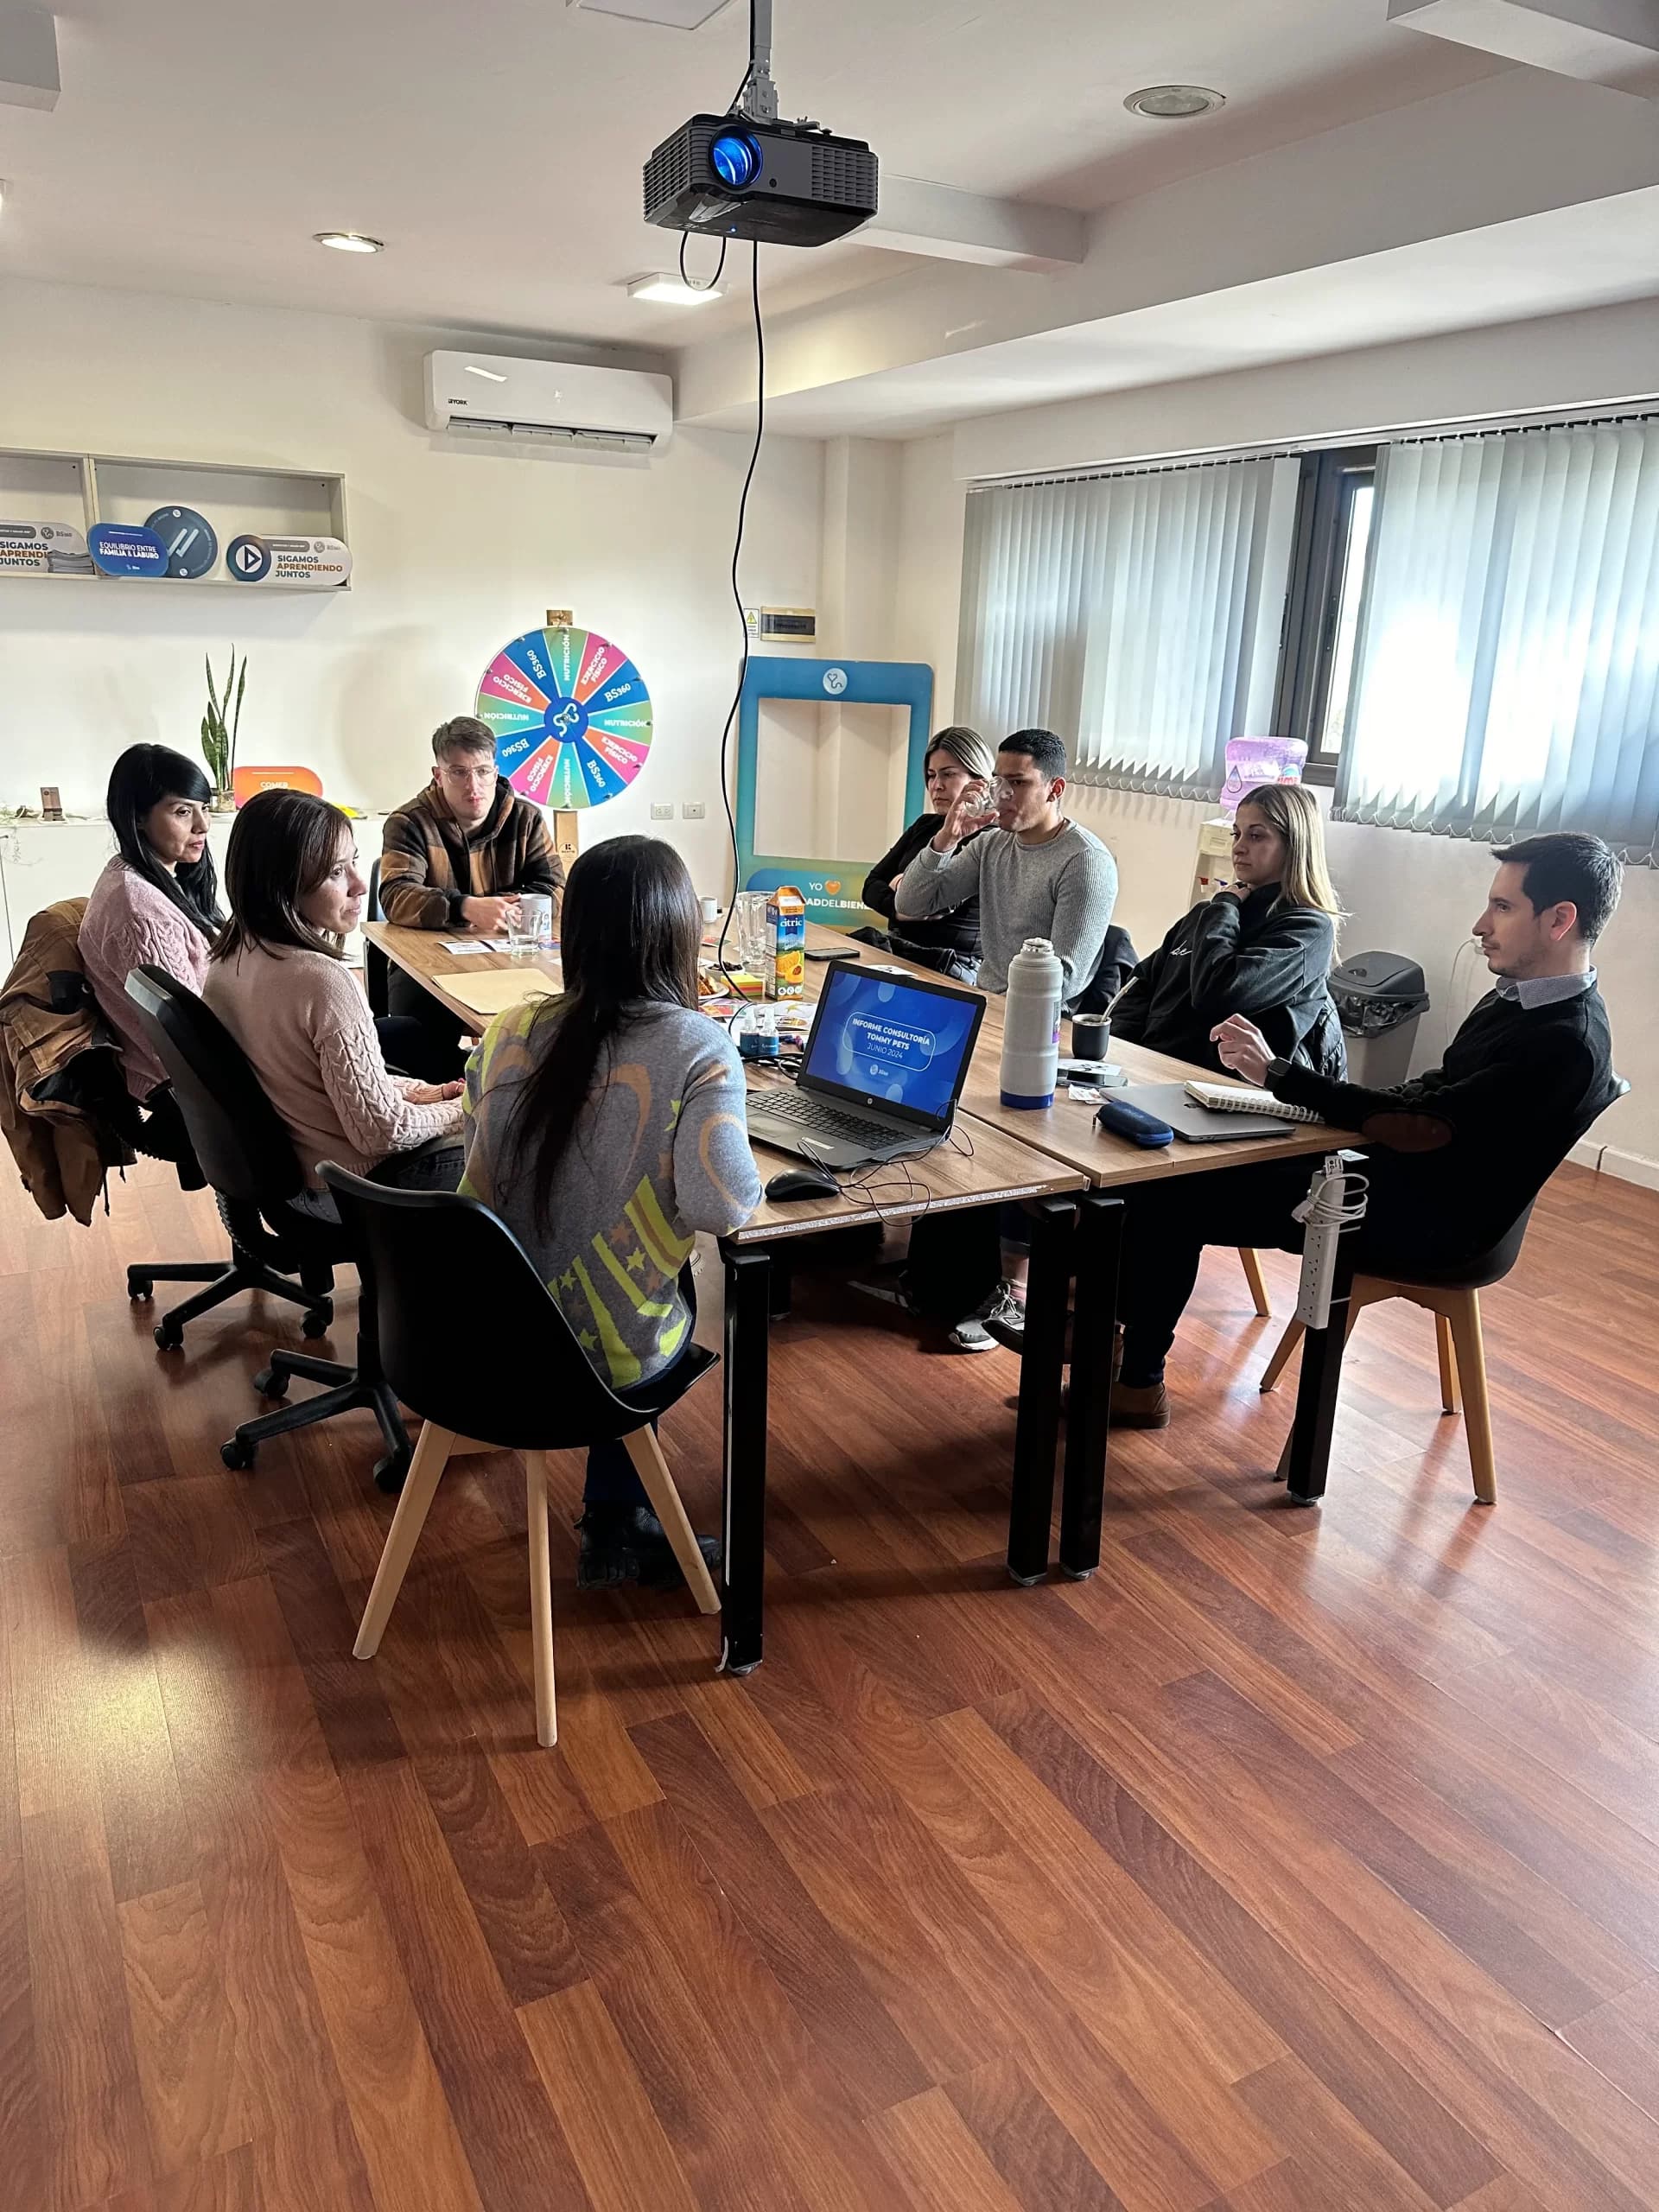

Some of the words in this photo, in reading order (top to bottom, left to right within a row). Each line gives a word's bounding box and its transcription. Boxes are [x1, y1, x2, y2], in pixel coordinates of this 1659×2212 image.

[0, 541, 48, 550] SIGAMOS
[99, 542, 136, 551] EQUILIBRIO
[0, 550, 48, 558] APRENDI
[132, 550, 159, 559] LABURO
[0, 557, 41, 566] JUNTOS
[277, 555, 319, 563] SIGAMOS
[276, 563, 343, 572] APRENDIENDO
[563, 634, 571, 681] NUTRICIÓN
[526, 649, 547, 680] BS360
[604, 683, 632, 702] BS360
[502, 738, 530, 757] BS360
[587, 760, 606, 788] BS360
[809, 882, 823, 891] YO
[780, 918, 803, 927] citric
[852, 1018, 882, 1032] INFORME
[883, 1027, 930, 1046] CONSULTORÍA
[867, 1032, 892, 1045] TOMMY
[892, 1039, 910, 1050] PETS
[867, 1043, 887, 1054] JUNIO
[888, 1049, 903, 1058] 2024
